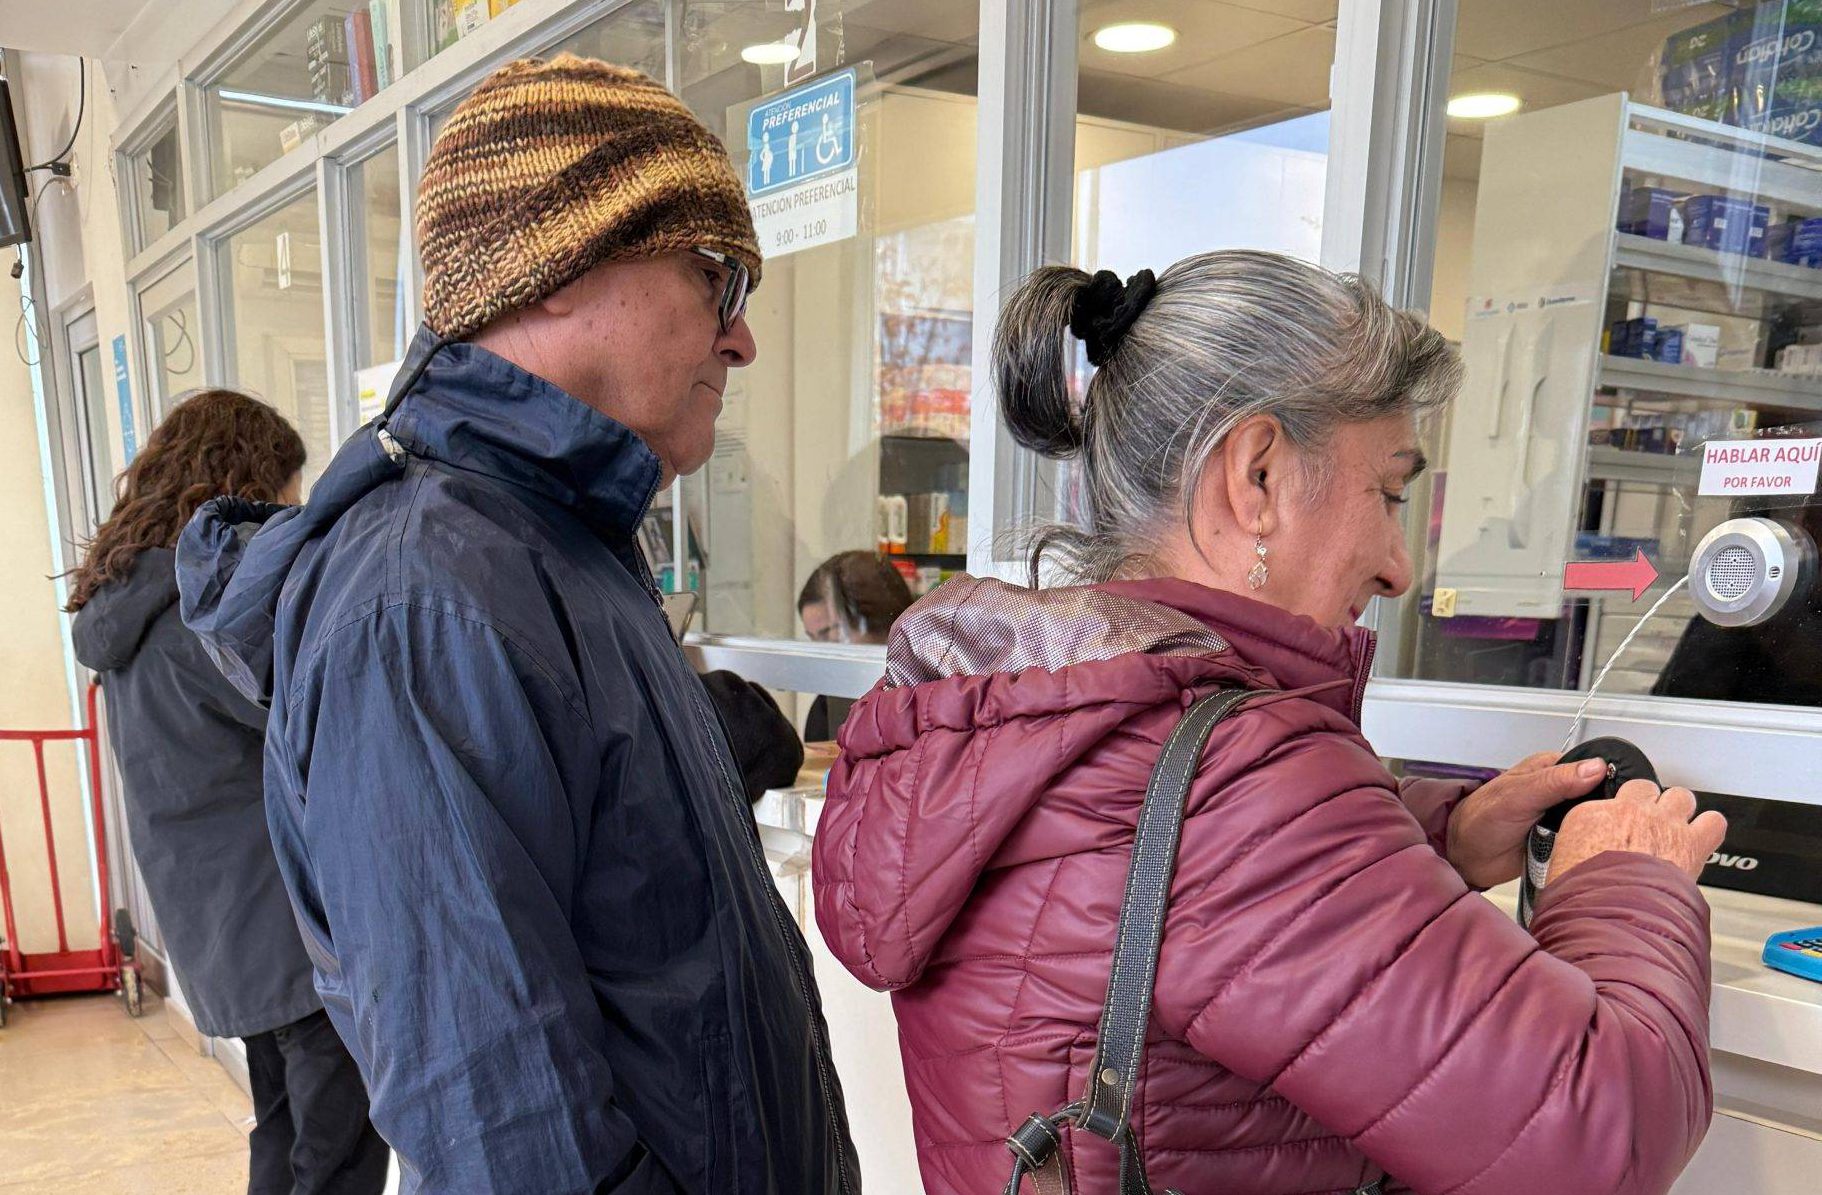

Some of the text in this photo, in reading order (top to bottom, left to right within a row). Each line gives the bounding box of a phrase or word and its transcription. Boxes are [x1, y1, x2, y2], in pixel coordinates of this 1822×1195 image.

[1736, 30, 1816, 65] Cotdian
[762, 91, 840, 131] PREFERENCIAL
[794, 176, 856, 209] PREFERENCIAL
[776, 228, 794, 247] 9:00
[803, 219, 827, 239] 11:00
[1706, 447, 1770, 464] HABLAR
[1724, 476, 1791, 488] POR FAVOR
[1705, 852, 1760, 870] ovo
